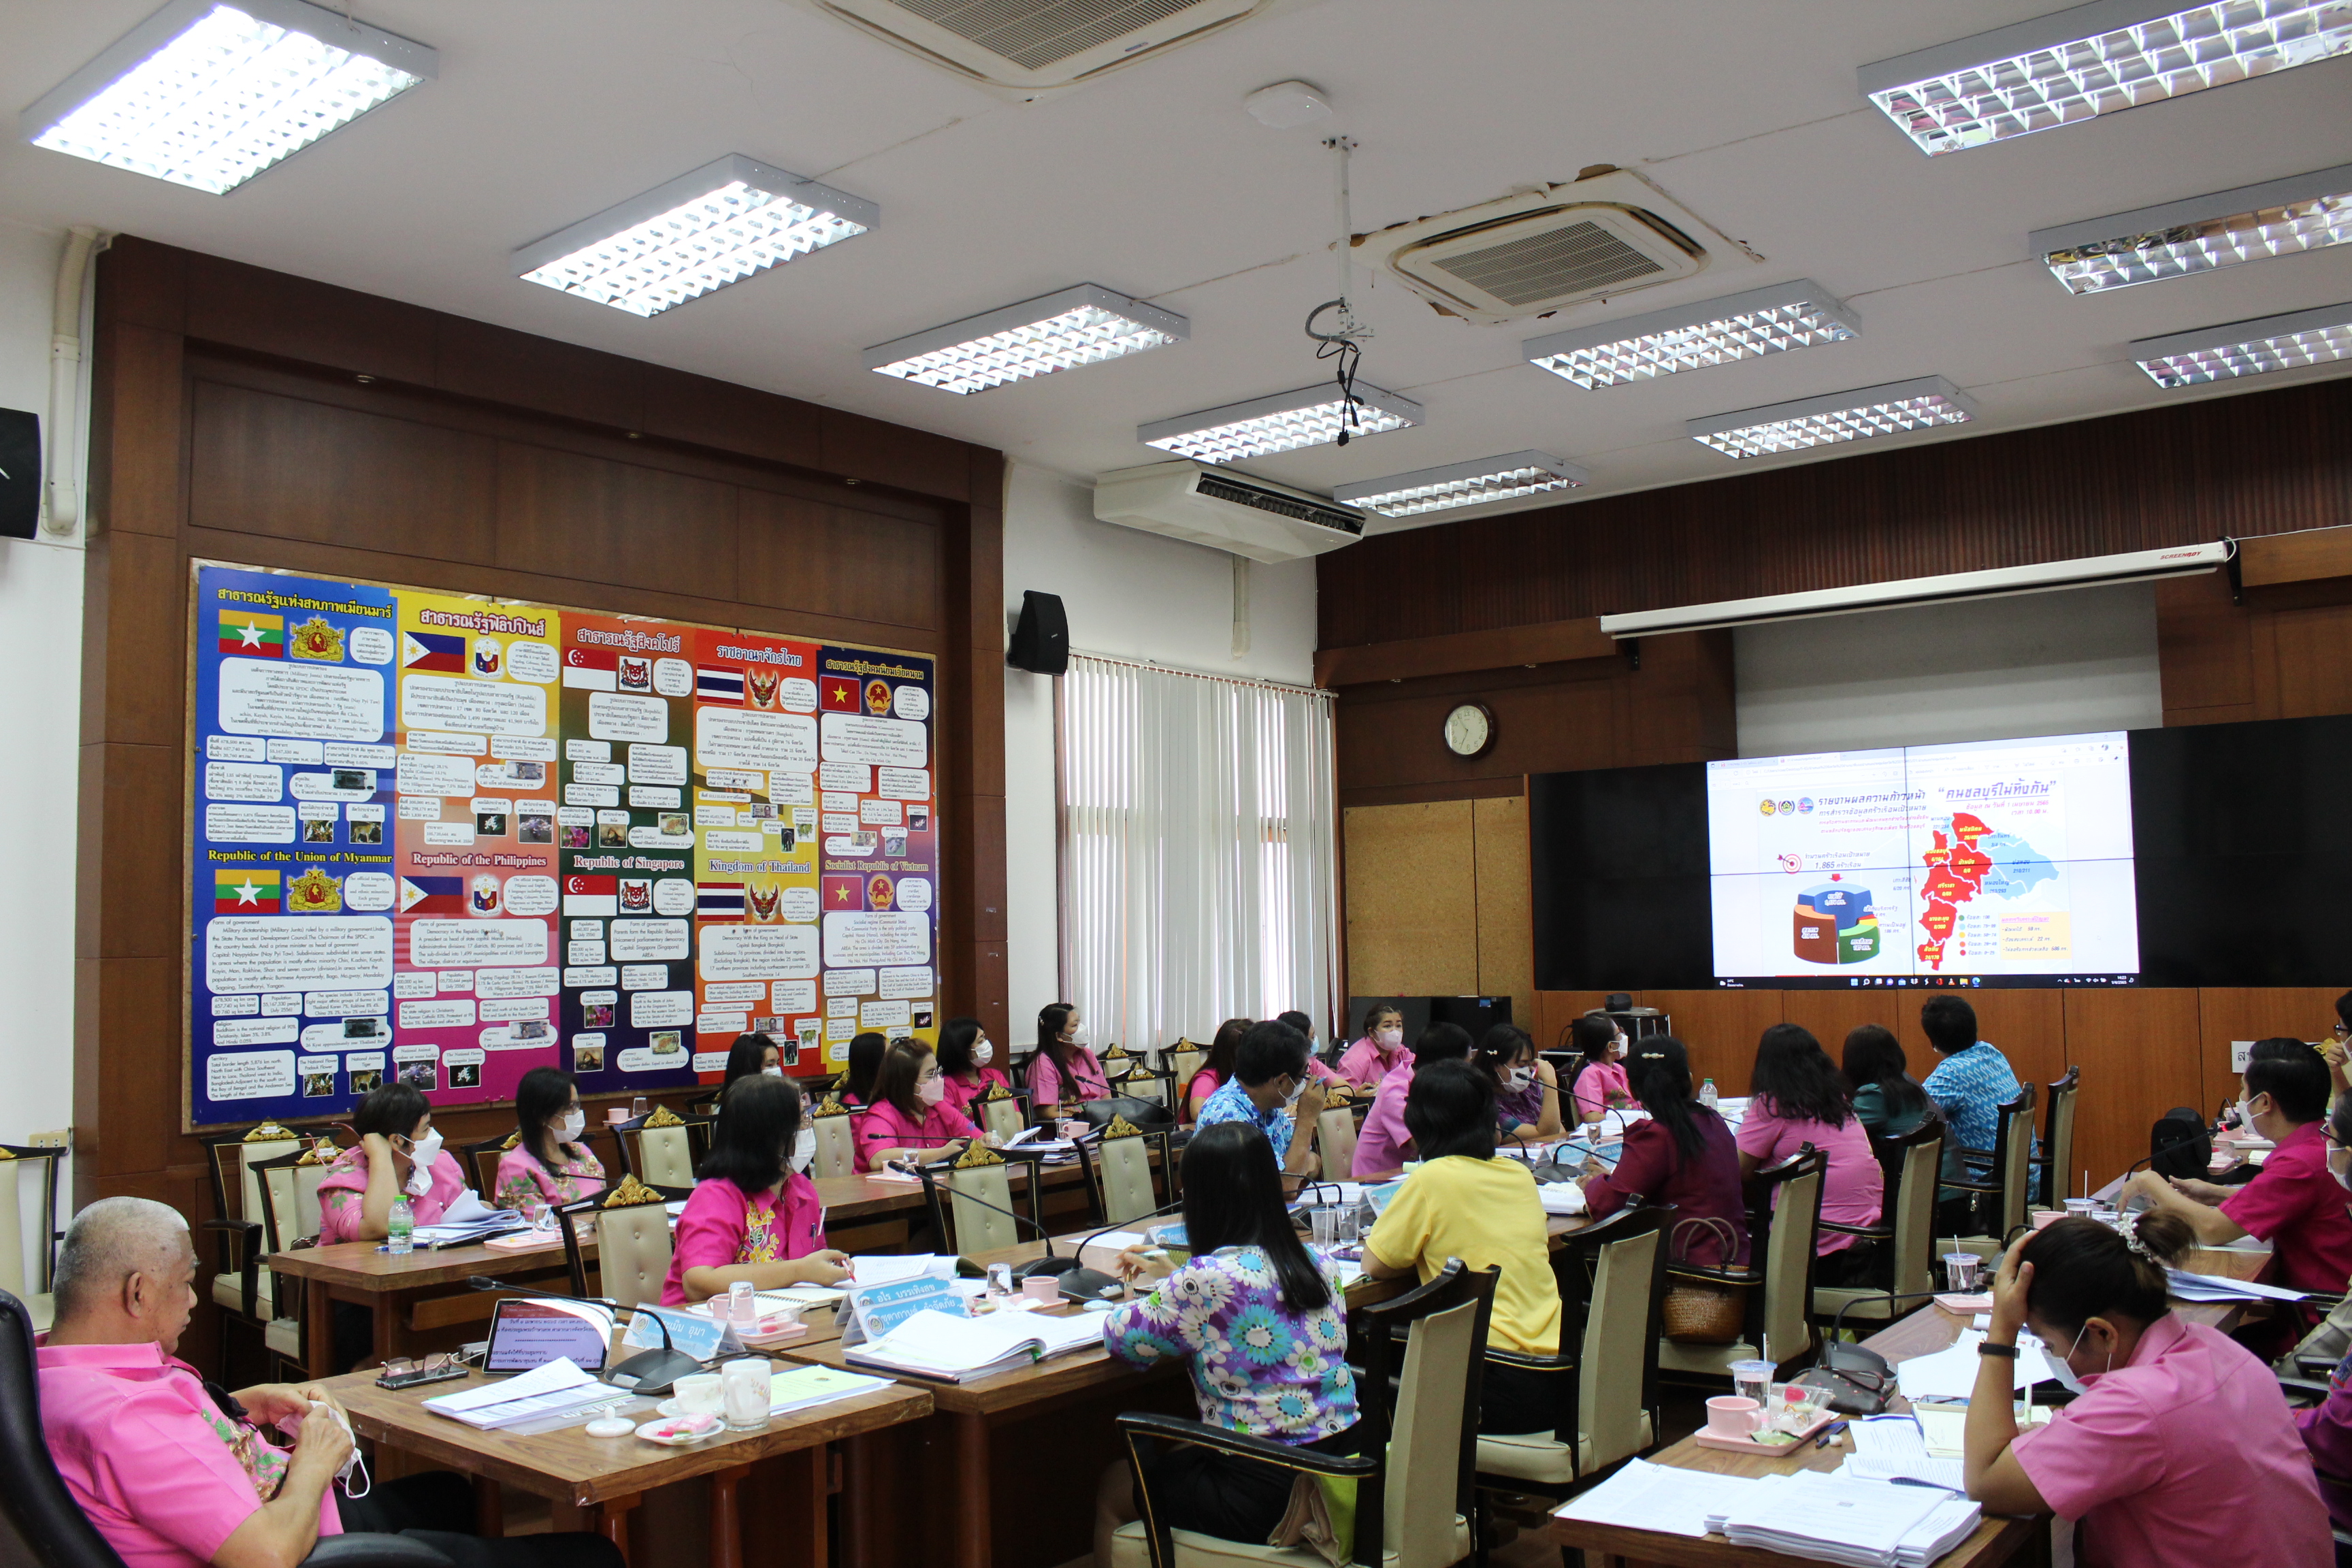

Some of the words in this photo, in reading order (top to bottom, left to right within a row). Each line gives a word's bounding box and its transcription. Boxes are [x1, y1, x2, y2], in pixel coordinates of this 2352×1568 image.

[218, 588, 392, 618] สาธารณรัฐแห่งสหภาพเมียนมาร์
[421, 609, 545, 637] สาธารณรัฐฟิลิปปินส์
[577, 628, 680, 653] สาธารณรัฐสิงคโปร์
[717, 645, 802, 667] ราชอาณาจักรไทย
[826, 659, 924, 680] สาธารณรัฐสังคมนิยมเวียดนาม
[1819, 789, 1925, 805] รายงานผลความก้าวหน้า
[1819, 804, 1926, 816] การสำรวจข้อมูลครัวเรือนเป้าหมาย
[208, 850, 256, 862] Republic
[260, 851, 272, 861] of
[275, 852, 291, 862] the
[295, 852, 326, 862] Union
[329, 852, 341, 862] of
[344, 853, 393, 864] Myanmar
[413, 853, 458, 866] Republic
[462, 854, 473, 865] of
[476, 854, 490, 865] the
[494, 854, 547, 868] Philippines
[574, 855, 620, 870] Republic
[622, 857, 633, 868] of
[636, 857, 684, 872] Singapore
[709, 859, 754, 874] Kingdom
[756, 860, 767, 872] of
[769, 861, 811, 873] Thailand
[825, 860, 856, 870] Socialist
[857, 860, 889, 872] Republic
[891, 862, 899, 870] of
[900, 862, 929, 871] Vietnam
[1815, 861, 1835, 870] 1,865
[688, 1326, 706, 1339] อุมา
